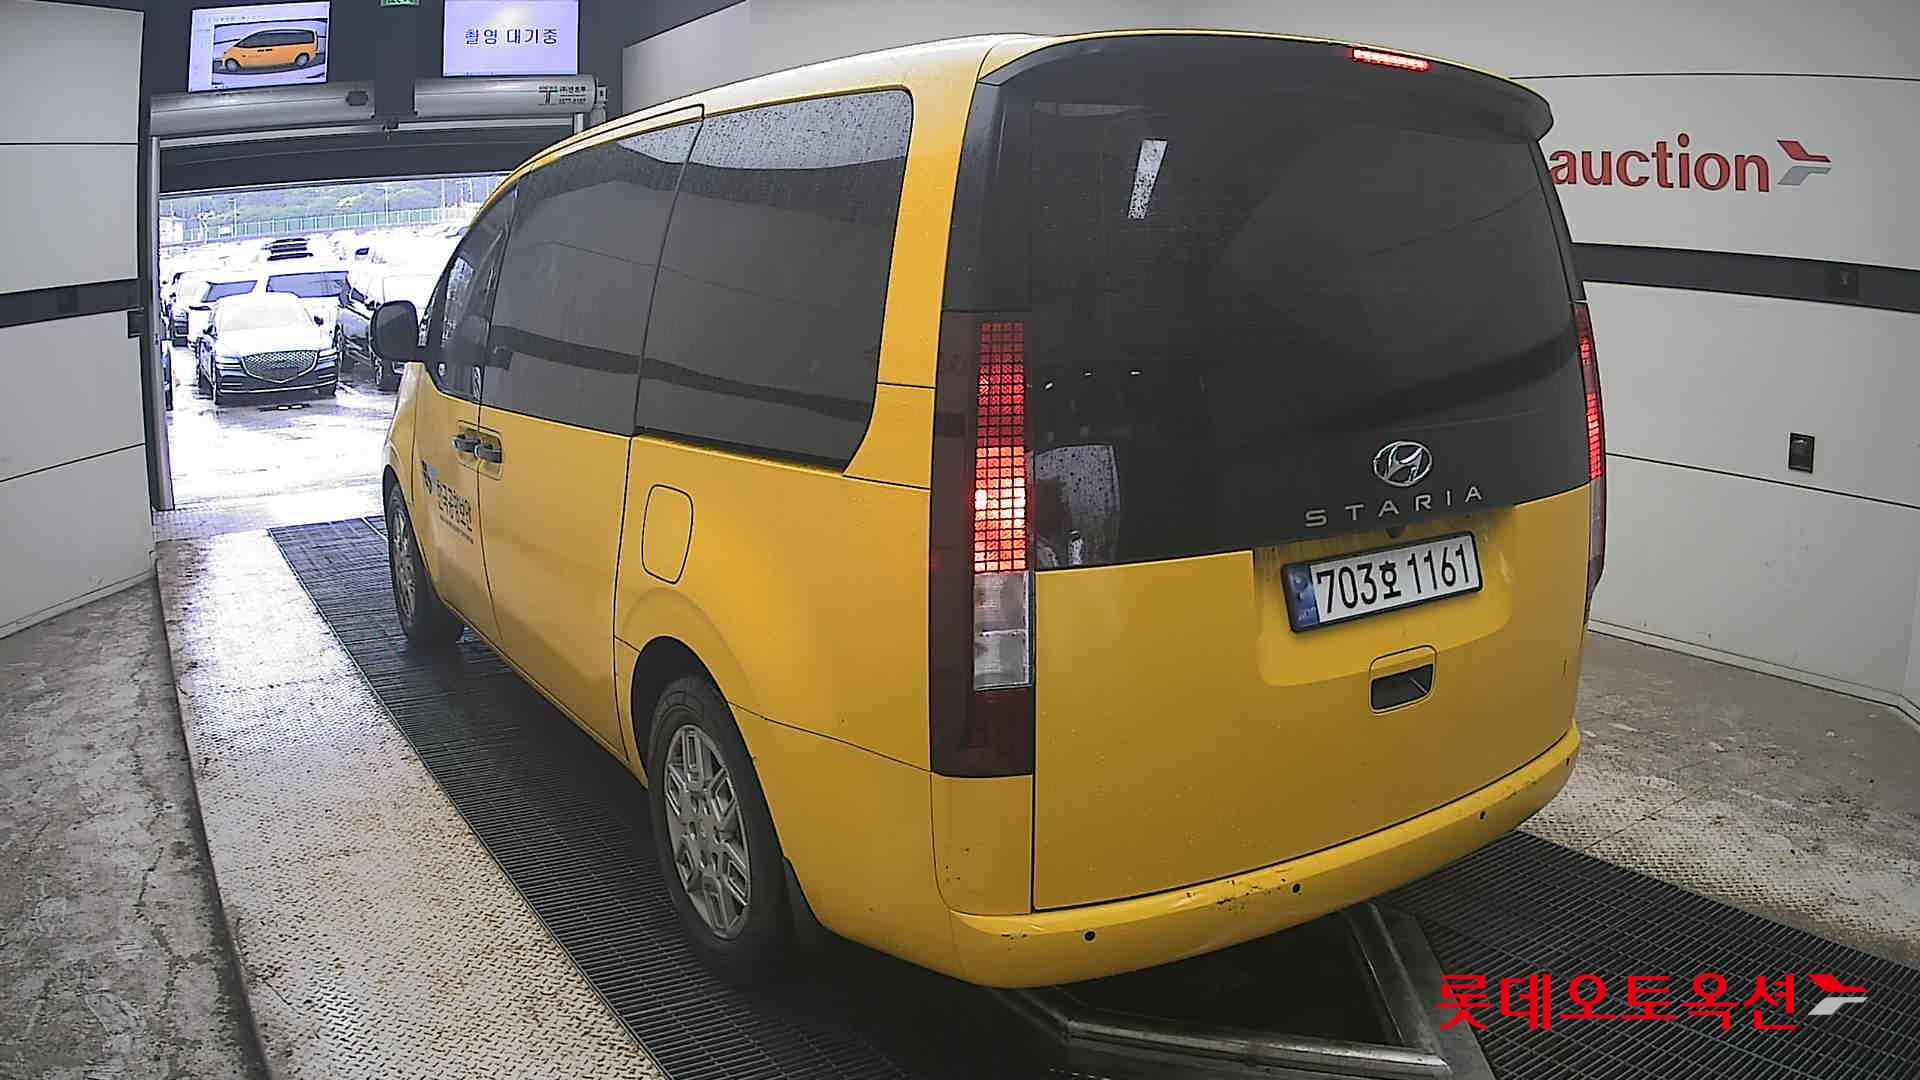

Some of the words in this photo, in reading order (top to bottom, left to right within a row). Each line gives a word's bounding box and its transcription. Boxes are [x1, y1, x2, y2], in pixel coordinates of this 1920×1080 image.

[506, 28, 558, 45] 대기중
[1549, 133, 1770, 193] auction
[1305, 486, 1482, 528] STARIA
[1316, 561, 1402, 614] 703호
[1407, 543, 1470, 594] 1161
